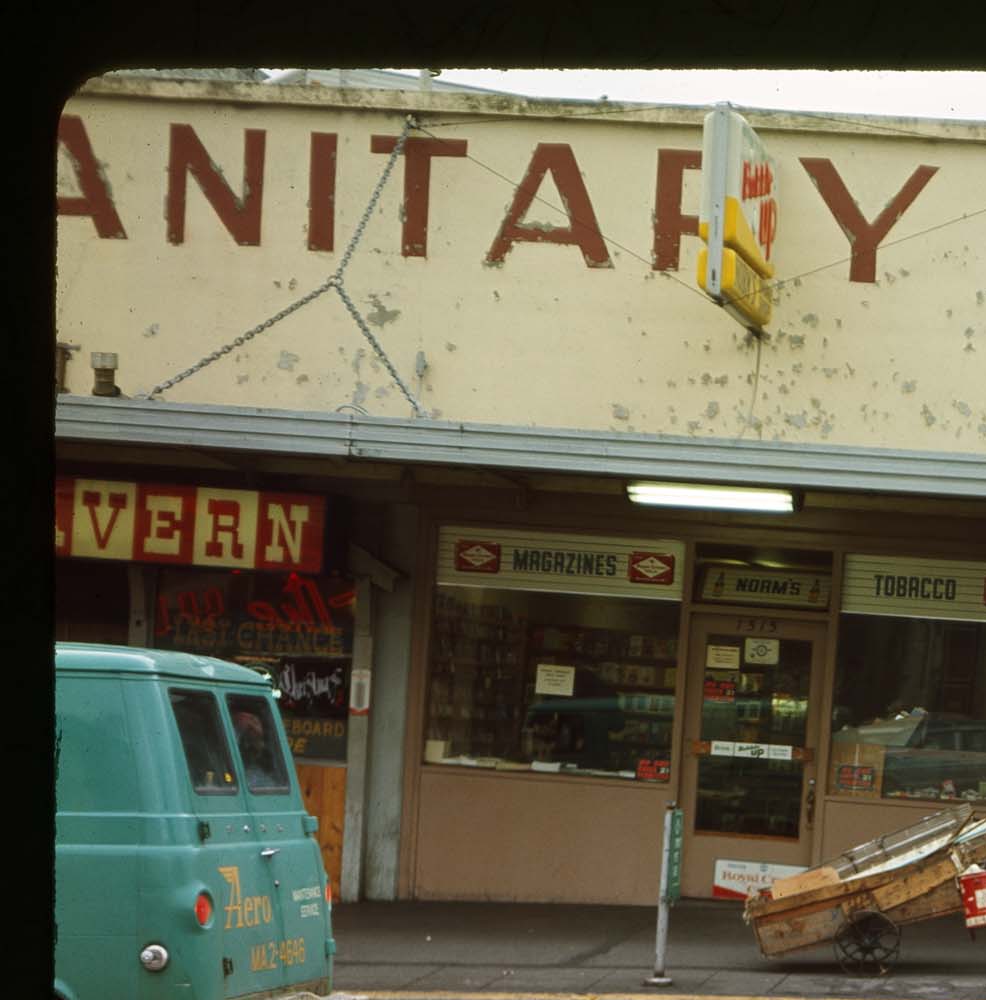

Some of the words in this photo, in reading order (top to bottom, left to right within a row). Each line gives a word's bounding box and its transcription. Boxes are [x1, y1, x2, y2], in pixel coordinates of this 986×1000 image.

[56, 490, 309, 564] VERN
[512, 548, 617, 576] MAGAZINES
[735, 576, 801, 595] NORM'S
[874, 574, 957, 600] TOBACCO
[218, 865, 273, 929] Aero
